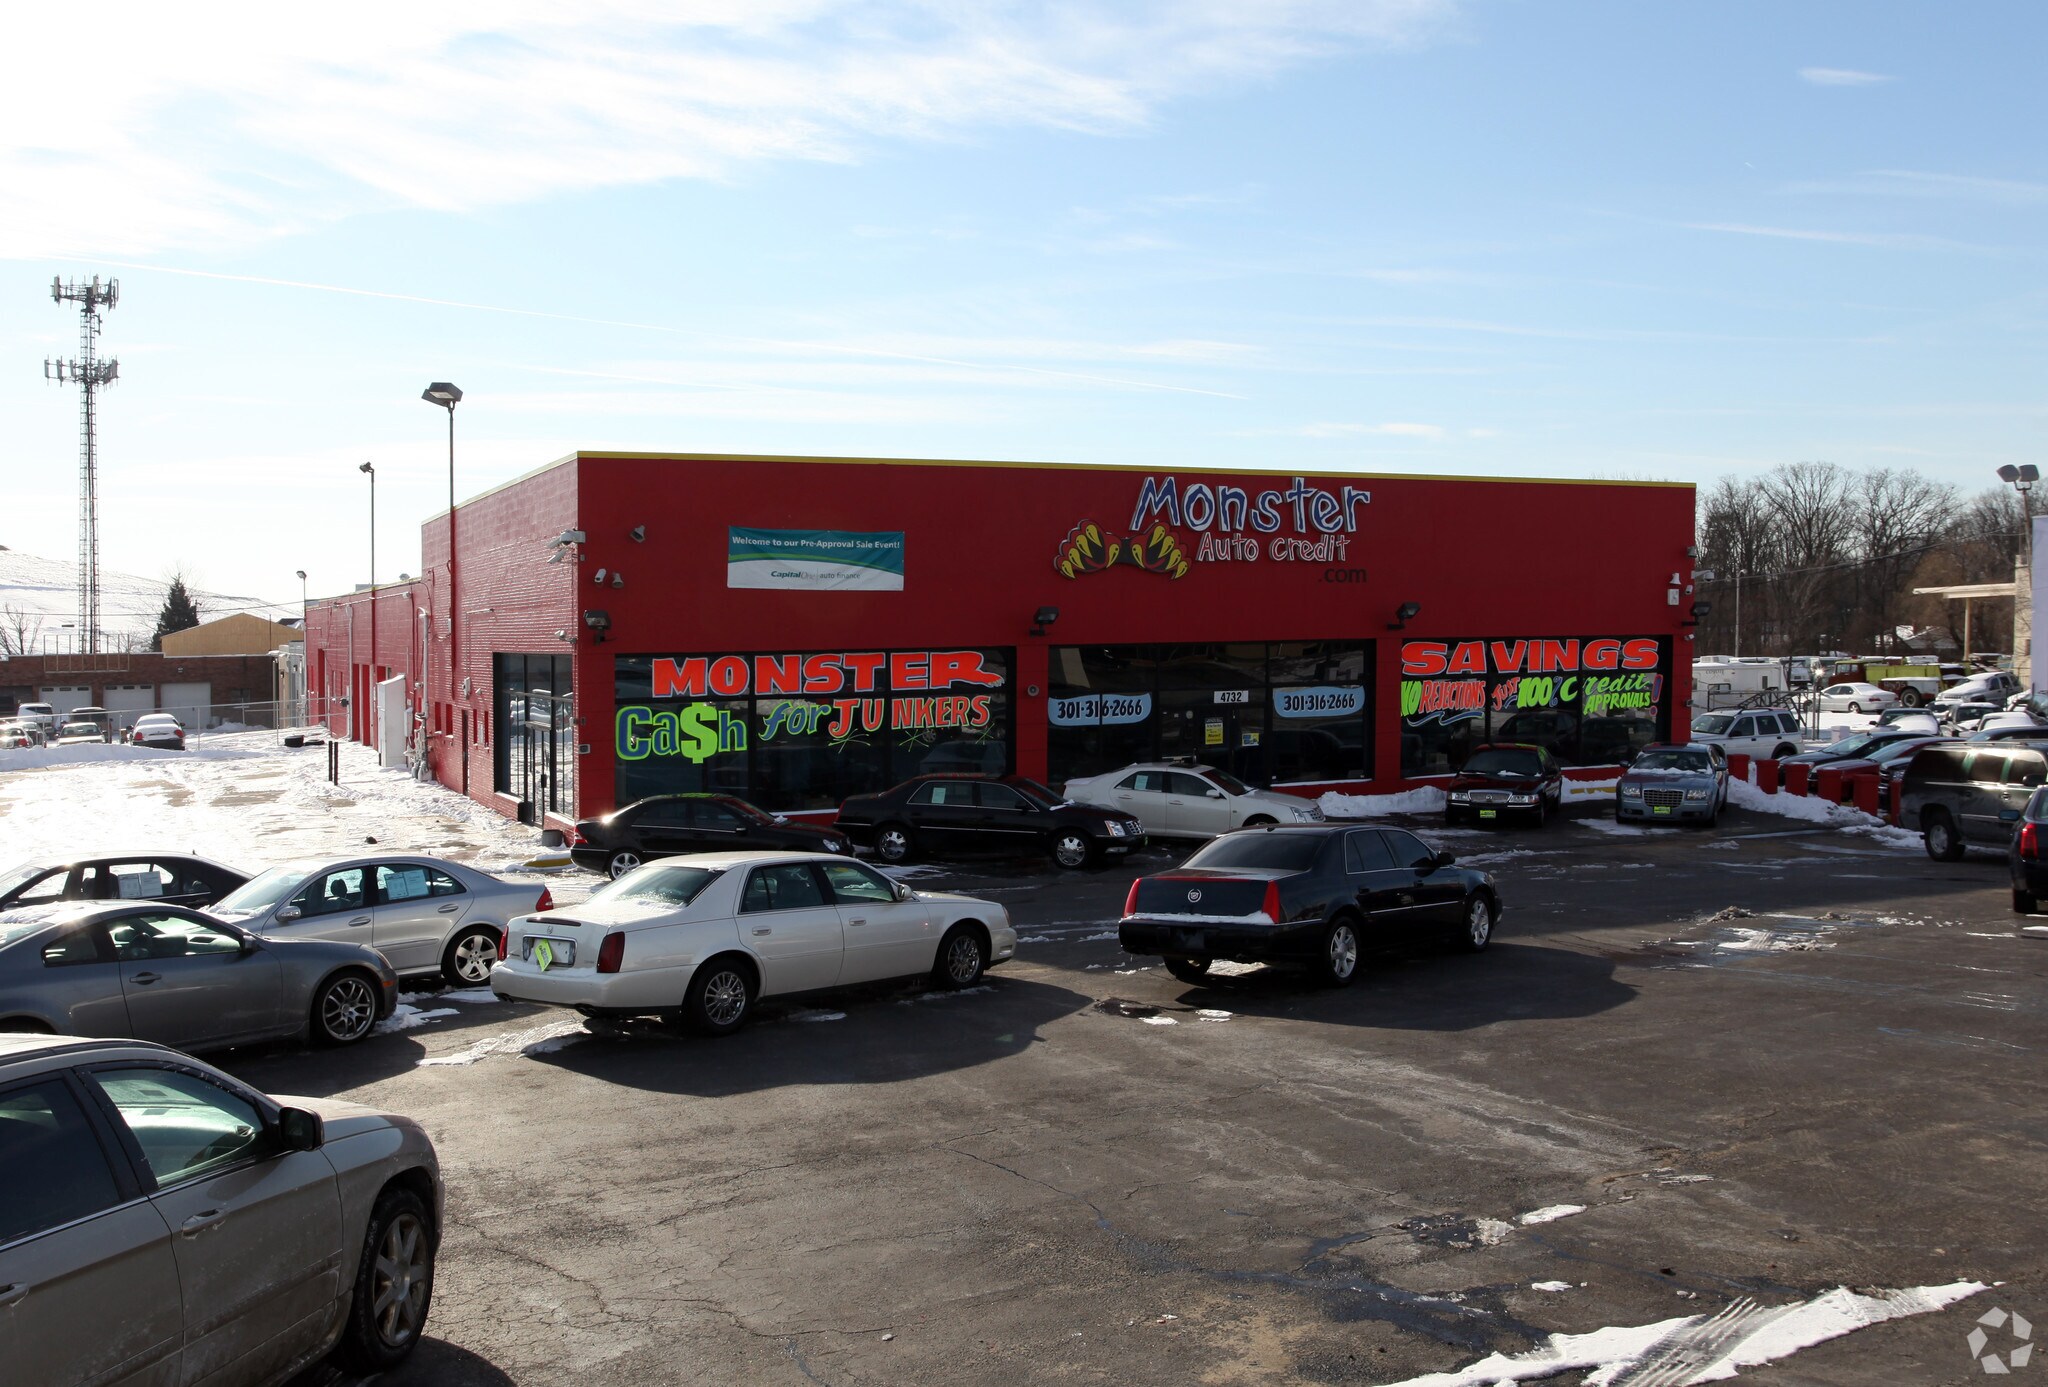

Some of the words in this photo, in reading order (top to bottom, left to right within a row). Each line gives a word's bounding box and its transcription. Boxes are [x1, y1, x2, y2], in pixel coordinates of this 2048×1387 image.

[1129, 476, 1371, 534] Monster
[732, 536, 771, 546] Welcome
[773, 539, 782, 547] to
[801, 540, 854, 549] Pre-Approval
[856, 541, 873, 549] Sale
[874, 541, 900, 549] Event!
[1196, 532, 1260, 562] Auto
[1269, 533, 1350, 562] credit
[837, 572, 861, 580] finance
[1318, 567, 1367, 583] .com
[1401, 638, 1659, 675] SAVINGS
[652, 651, 1005, 698] MONSTER
[1220, 692, 1242, 702] 4732
[1400, 680, 1423, 717] NO
[1418, 680, 1486, 714] REJECTIONS
[1491, 677, 1521, 711] JUST
[1516, 676, 1563, 709] 100%
[616, 702, 748, 764] Ca$h
[758, 701, 832, 741] for
